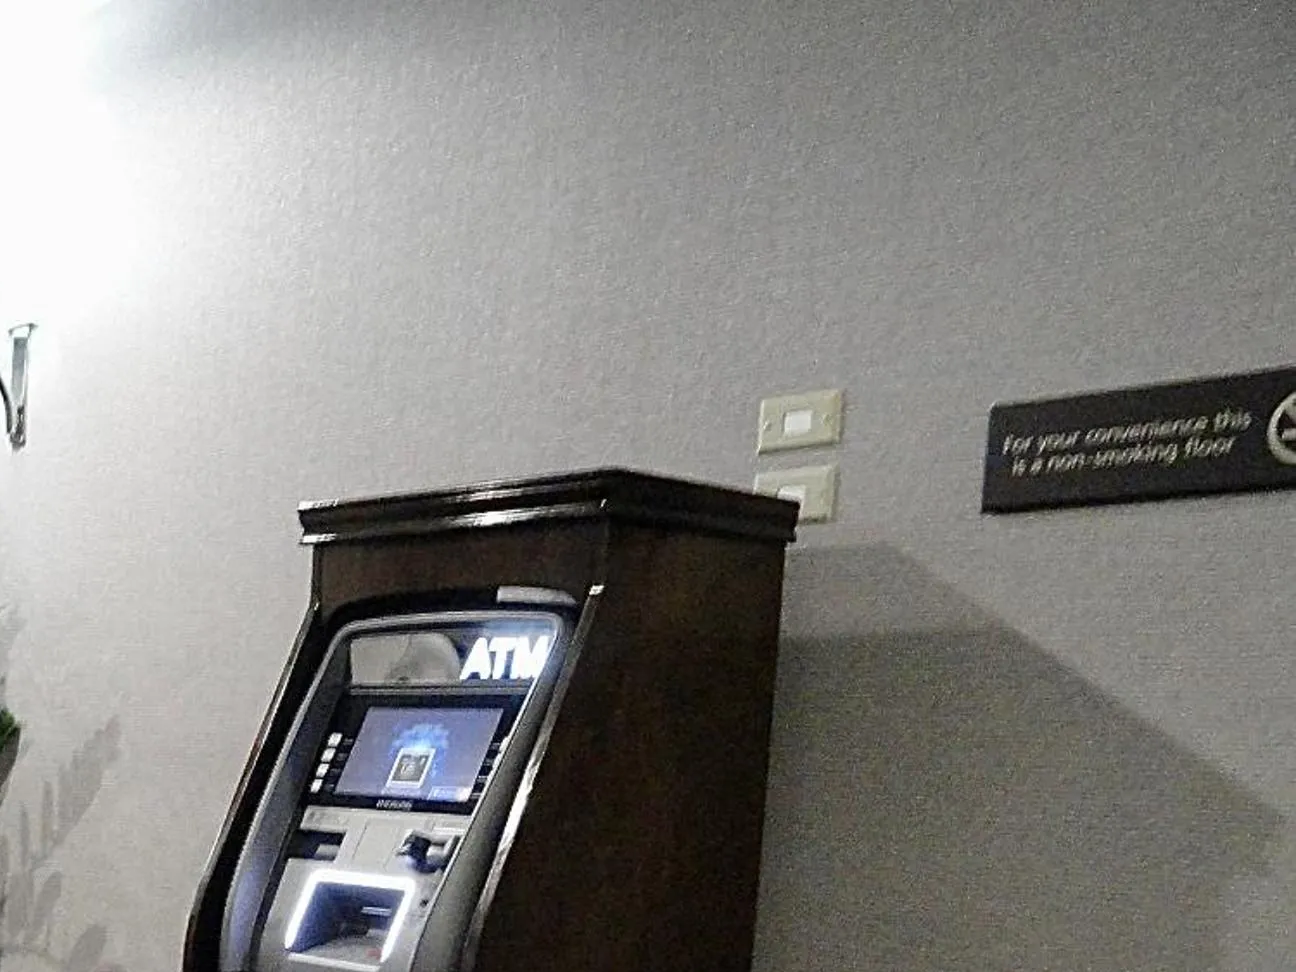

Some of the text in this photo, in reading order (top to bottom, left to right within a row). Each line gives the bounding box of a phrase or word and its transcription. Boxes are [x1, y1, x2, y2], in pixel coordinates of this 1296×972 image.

[1002, 405, 1253, 456] For your convenience this
[1029, 457, 1043, 477] a
[1184, 436, 1237, 458] floor
[459, 635, 550, 681] ATM
